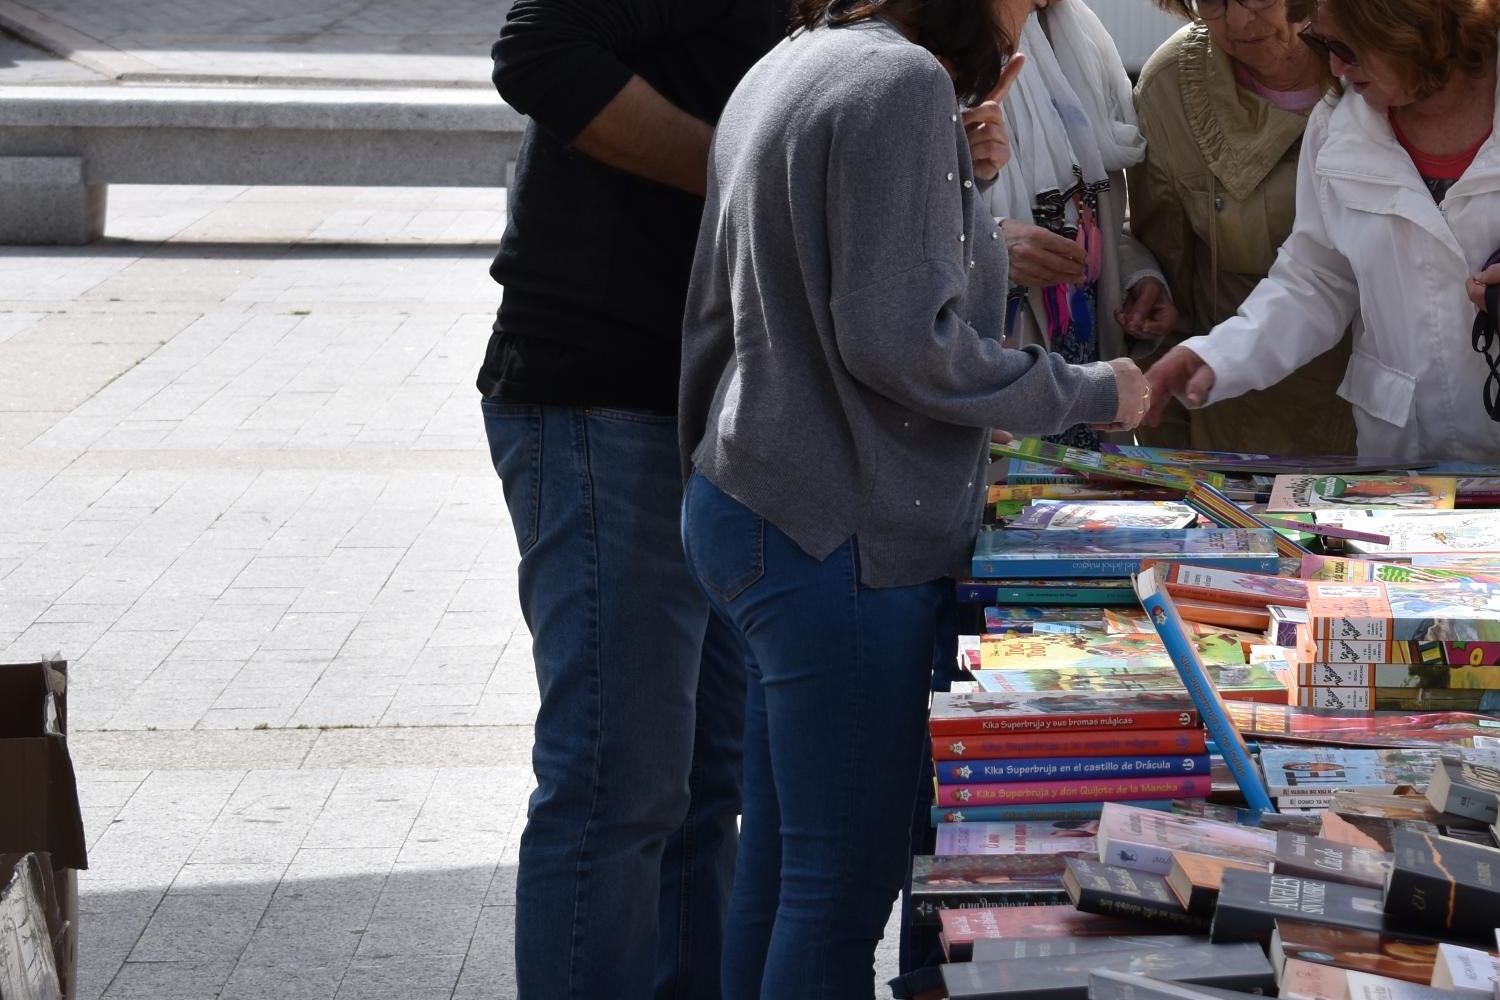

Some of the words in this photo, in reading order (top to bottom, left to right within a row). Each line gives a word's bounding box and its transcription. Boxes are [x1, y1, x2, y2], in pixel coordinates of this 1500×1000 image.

[1072, 561, 1100, 572] mágico
[1101, 562, 1123, 573] árbol
[982, 720, 1000, 730] Kika
[1000, 718, 1046, 731] Superbruja
[1046, 721, 1052, 729] y
[1053, 720, 1067, 728] sus
[1068, 717, 1100, 727] bromas
[1101, 716, 1133, 728] mágicas
[984, 764, 1004, 775] Kika
[1006, 762, 1058, 775] Superbruja
[1060, 764, 1071, 772] en
[1073, 762, 1082, 771] el
[1084, 761, 1119, 771] castillo
[1121, 760, 1133, 770] de
[1135, 759, 1171, 770] Drácula
[976, 788, 997, 799] Kika
[998, 786, 1050, 799] Superbruja
[1051, 788, 1057, 798] y
[1059, 785, 1078, 796] don
[1080, 783, 1115, 797] Quijote
[1116, 784, 1128, 794] de
[1130, 783, 1139, 793] la
[1140, 781, 1178, 793] Mancha
[1259, 875, 1301, 911] ÁNGELES
[1303, 880, 1326, 903] NOMBRE
[1302, 902, 1325, 915] SIN
